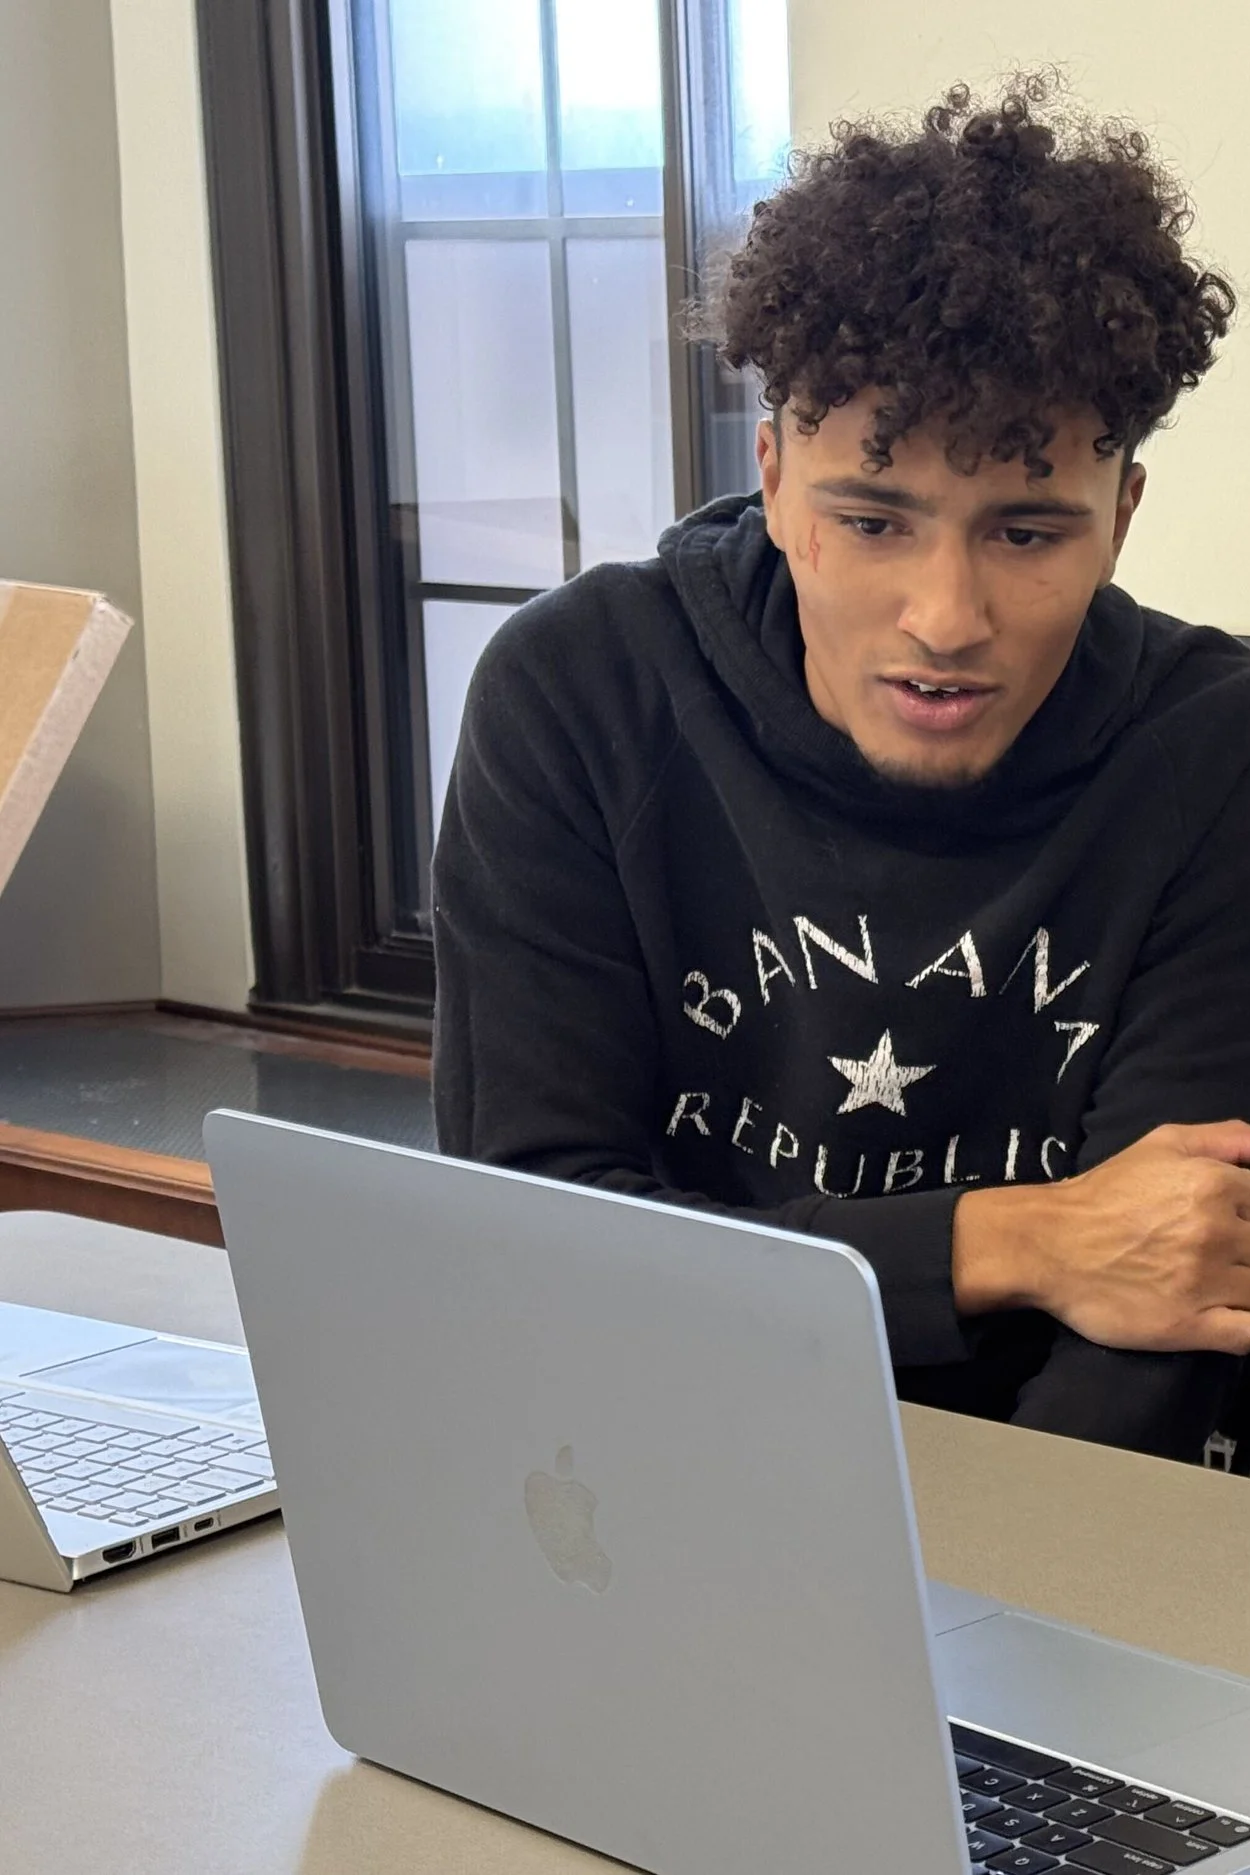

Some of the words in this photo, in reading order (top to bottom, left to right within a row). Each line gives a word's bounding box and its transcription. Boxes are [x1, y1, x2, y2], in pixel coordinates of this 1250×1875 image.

[1027, 1792, 1043, 1801] X
[1004, 1818, 1020, 1827] S
[1050, 1834, 1066, 1842] A
